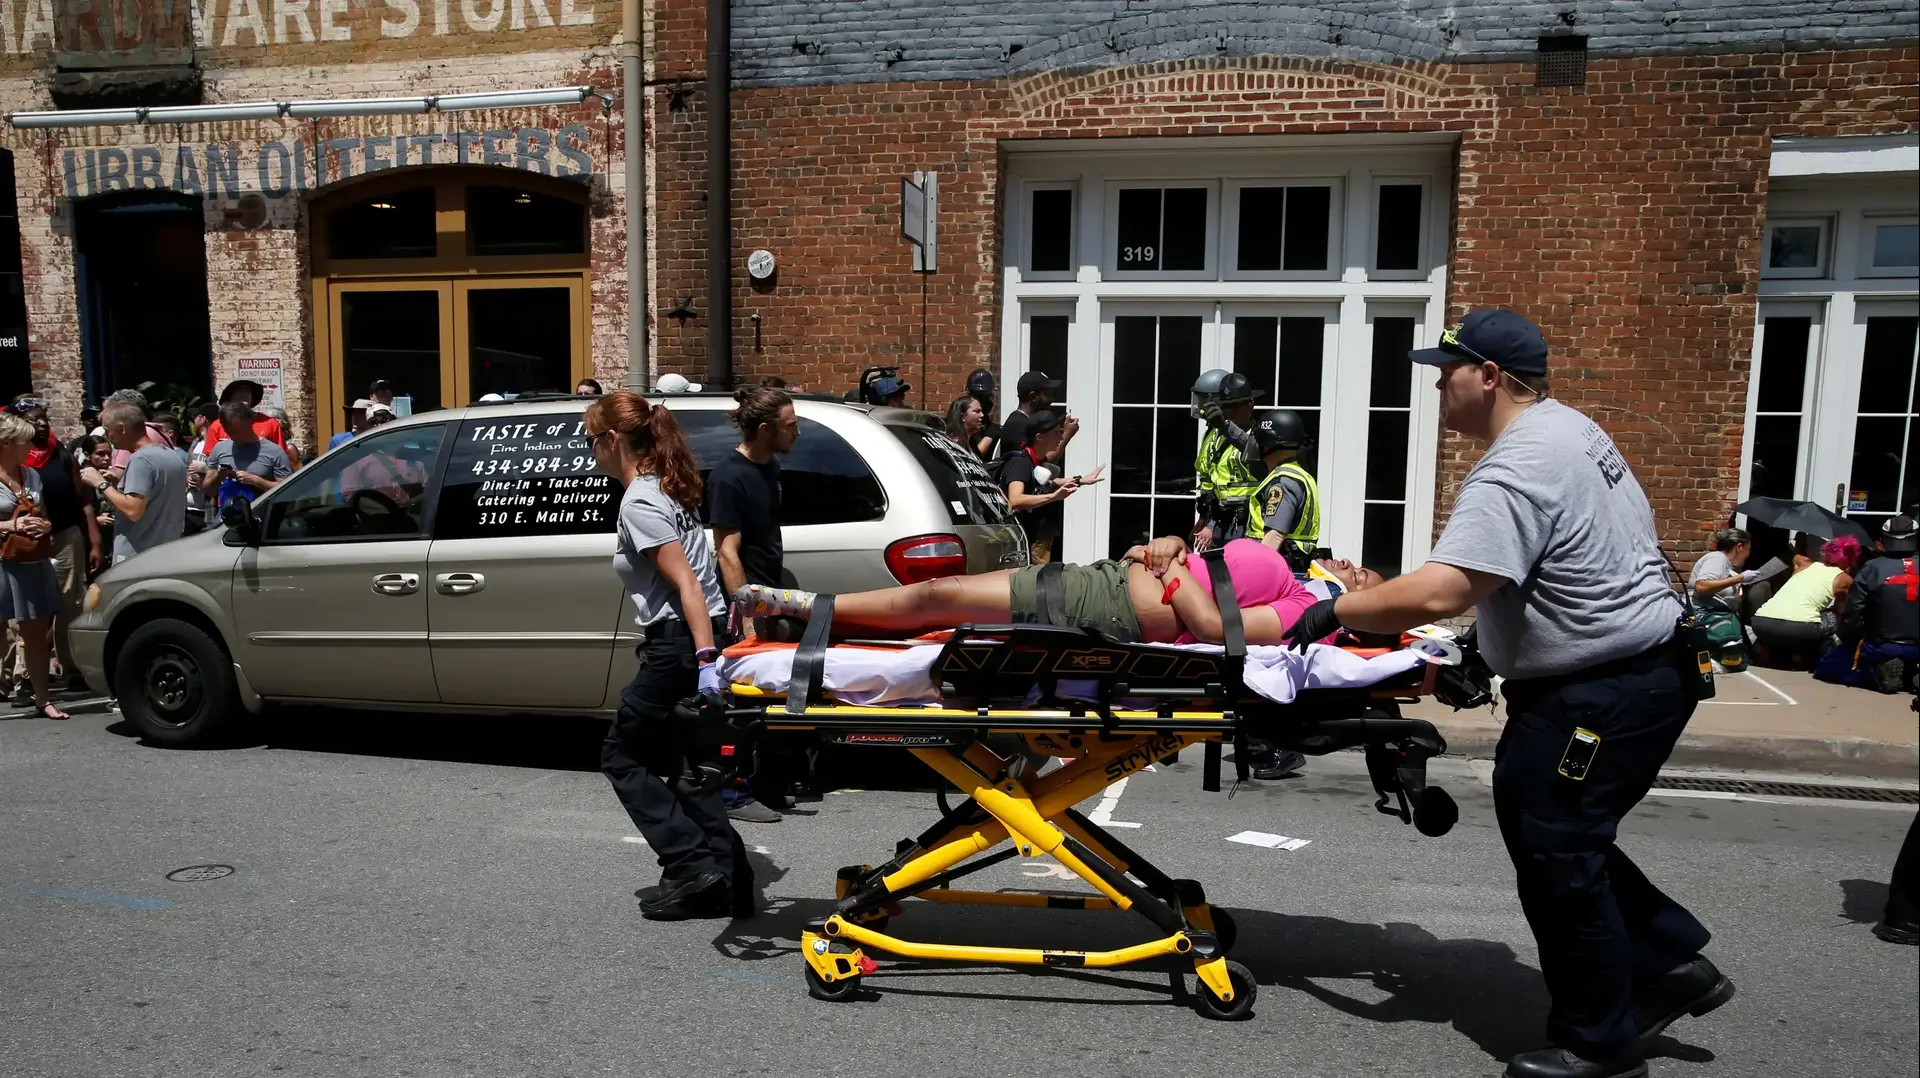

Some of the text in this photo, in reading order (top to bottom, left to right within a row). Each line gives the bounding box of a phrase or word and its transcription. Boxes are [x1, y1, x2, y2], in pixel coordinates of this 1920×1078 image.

[64, 124, 592, 200] URBAN OUTFITTERS
[1124, 246, 1154, 261] 319
[240, 359, 279, 368] WARNING
[472, 423, 538, 441] TASTE
[546, 422, 566, 437] of
[490, 440, 590, 456] Fine Indian Cui
[482, 476, 609, 491] Dine-In Take-Out
[477, 492, 610, 507] Catering Delivery
[479, 509, 604, 525] 310 E. Main St.
[1072, 655, 1111, 665] XPS
[1105, 735, 1185, 781] stryker
